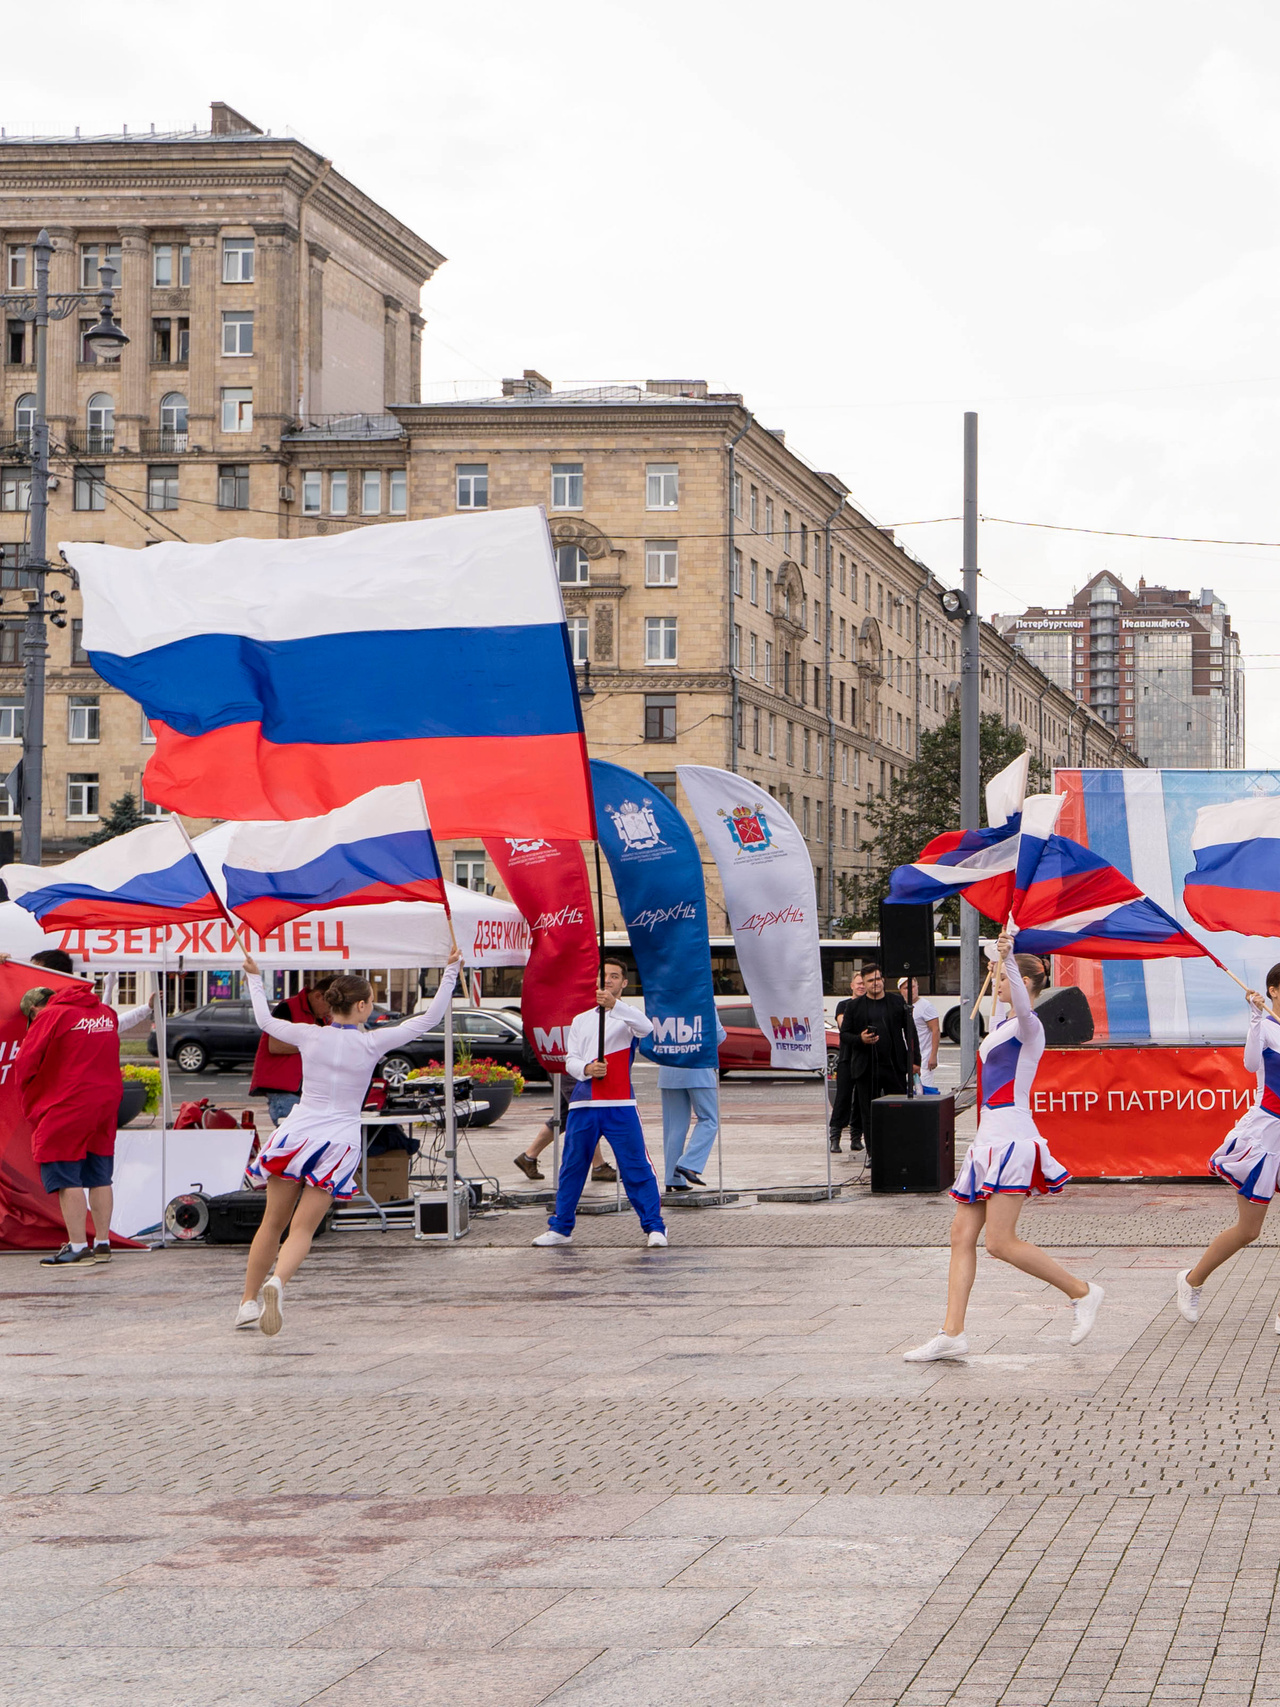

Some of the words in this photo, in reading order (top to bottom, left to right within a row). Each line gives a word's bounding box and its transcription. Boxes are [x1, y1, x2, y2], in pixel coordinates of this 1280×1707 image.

[1015, 619, 1084, 630] Петербургская
[1121, 619, 1190, 630] Недвижимость
[1030, 1091, 1099, 1114] ЕНТР
